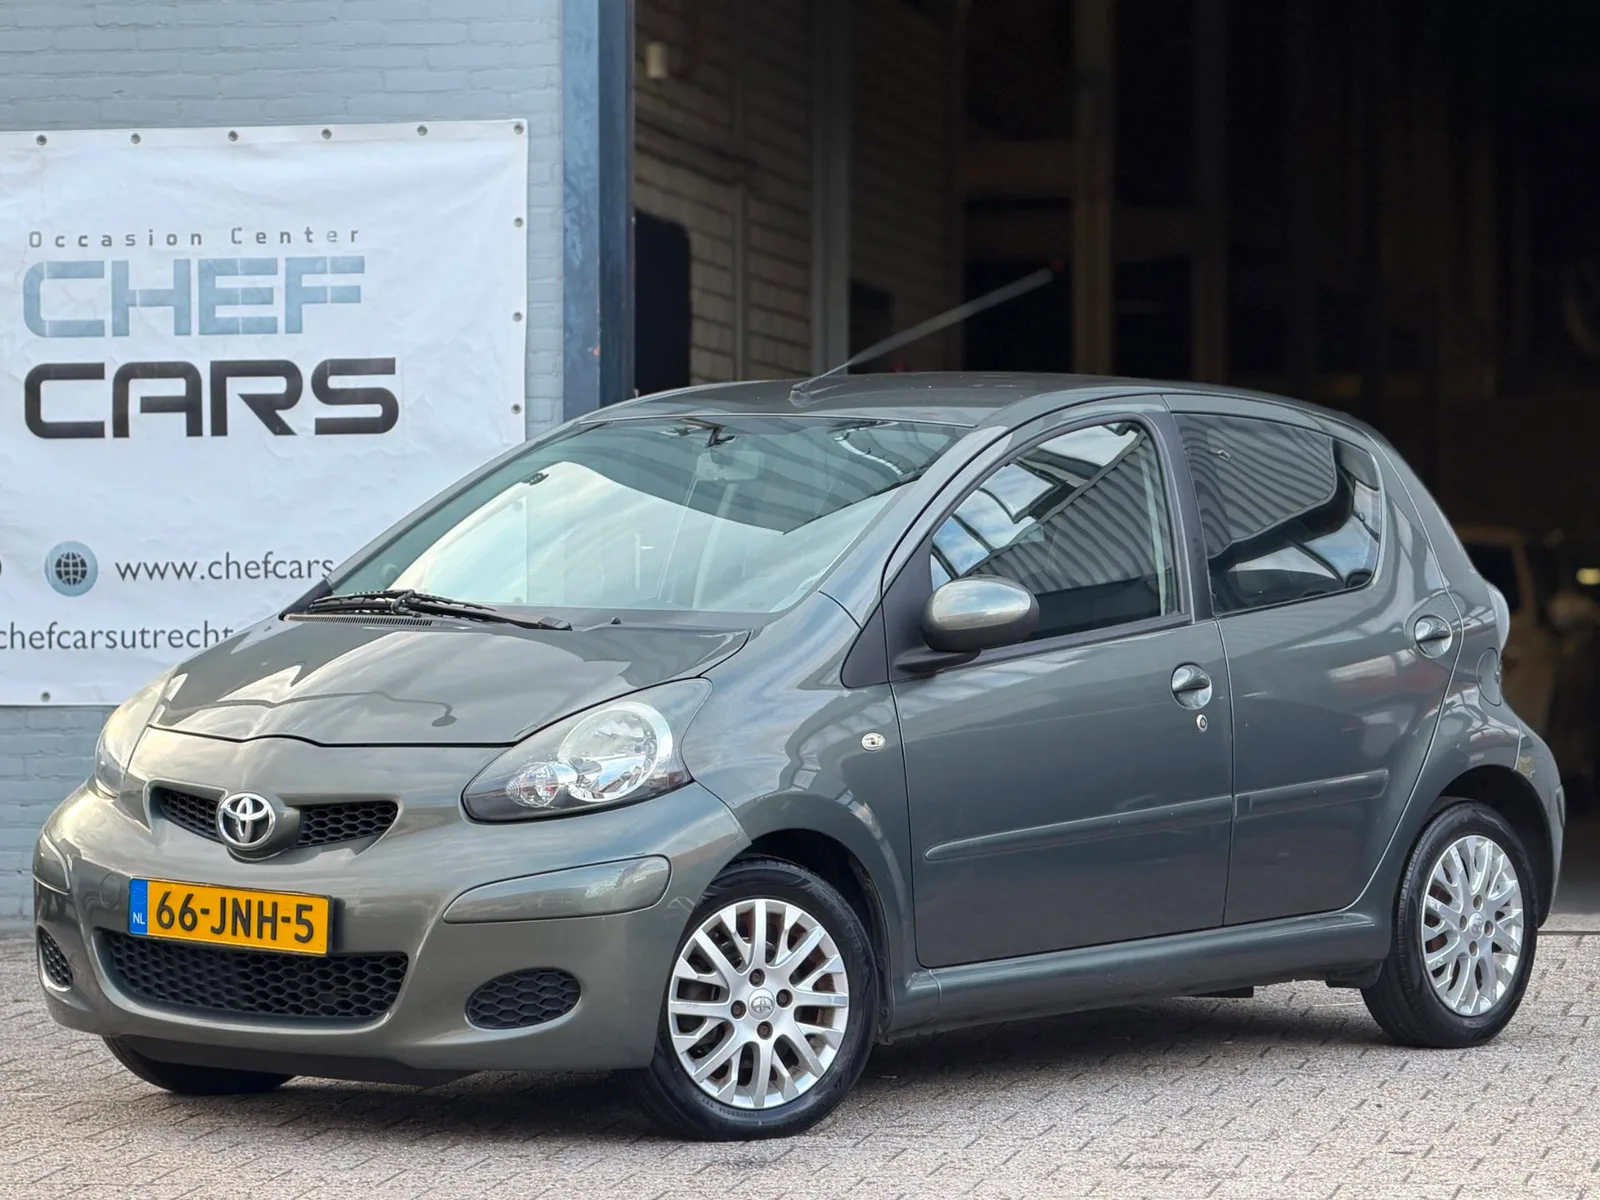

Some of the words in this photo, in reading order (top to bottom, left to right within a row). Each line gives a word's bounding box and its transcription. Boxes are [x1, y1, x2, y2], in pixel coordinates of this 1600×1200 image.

[28, 229, 203, 249] Occasion
[230, 226, 361, 245] Center
[22, 256, 366, 338] CHEF
[24, 357, 400, 440] CARS
[115, 551, 334, 581] www.chefcars
[132, 911, 146, 926] NL
[156, 891, 314, 944] 66-JNH-5
